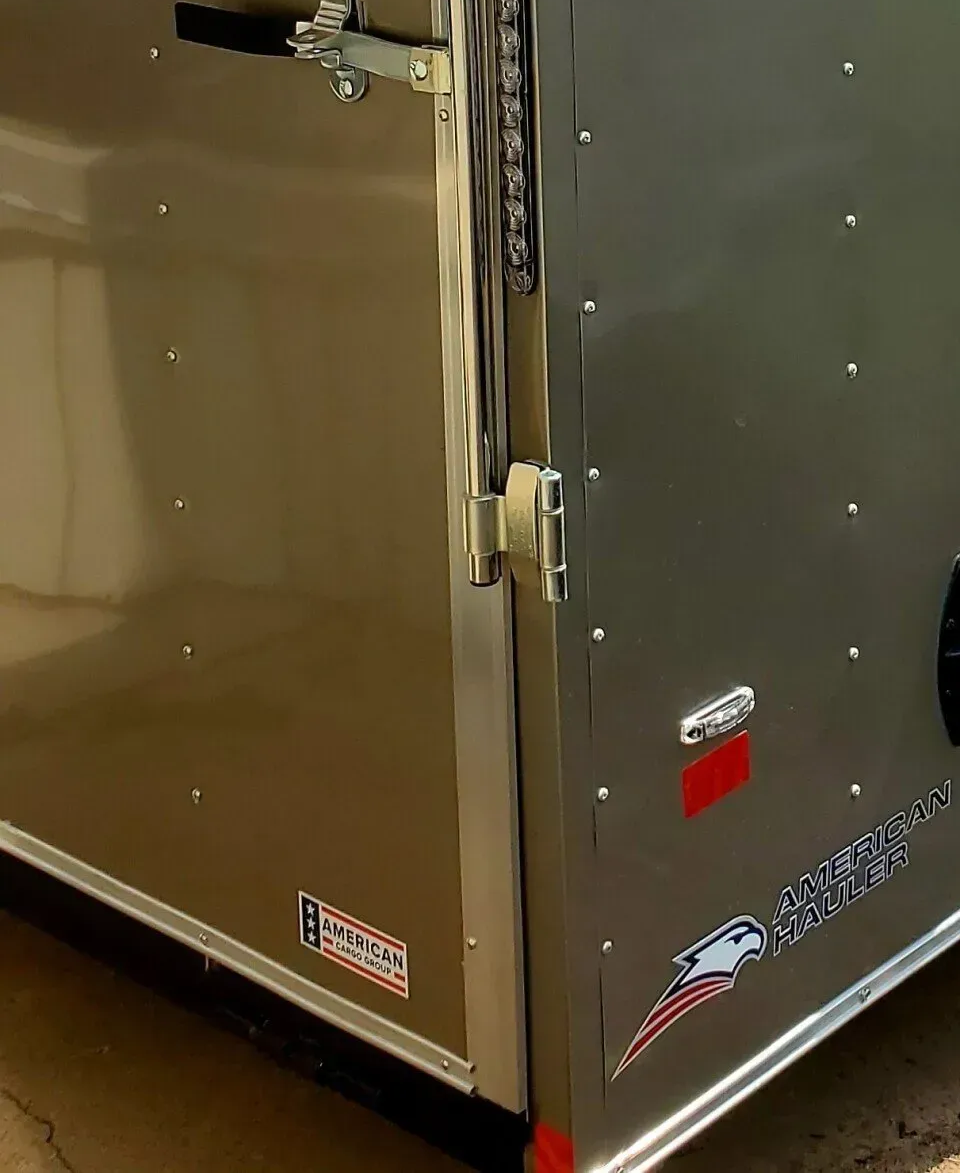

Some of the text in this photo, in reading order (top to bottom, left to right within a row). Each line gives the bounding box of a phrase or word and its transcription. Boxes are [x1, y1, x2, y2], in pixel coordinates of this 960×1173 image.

[772, 779, 952, 924] AMERICAN
[773, 841, 909, 957] HAULER
[322, 917, 404, 971] AMERICAN
[335, 941, 392, 975] CARGO GROUP
